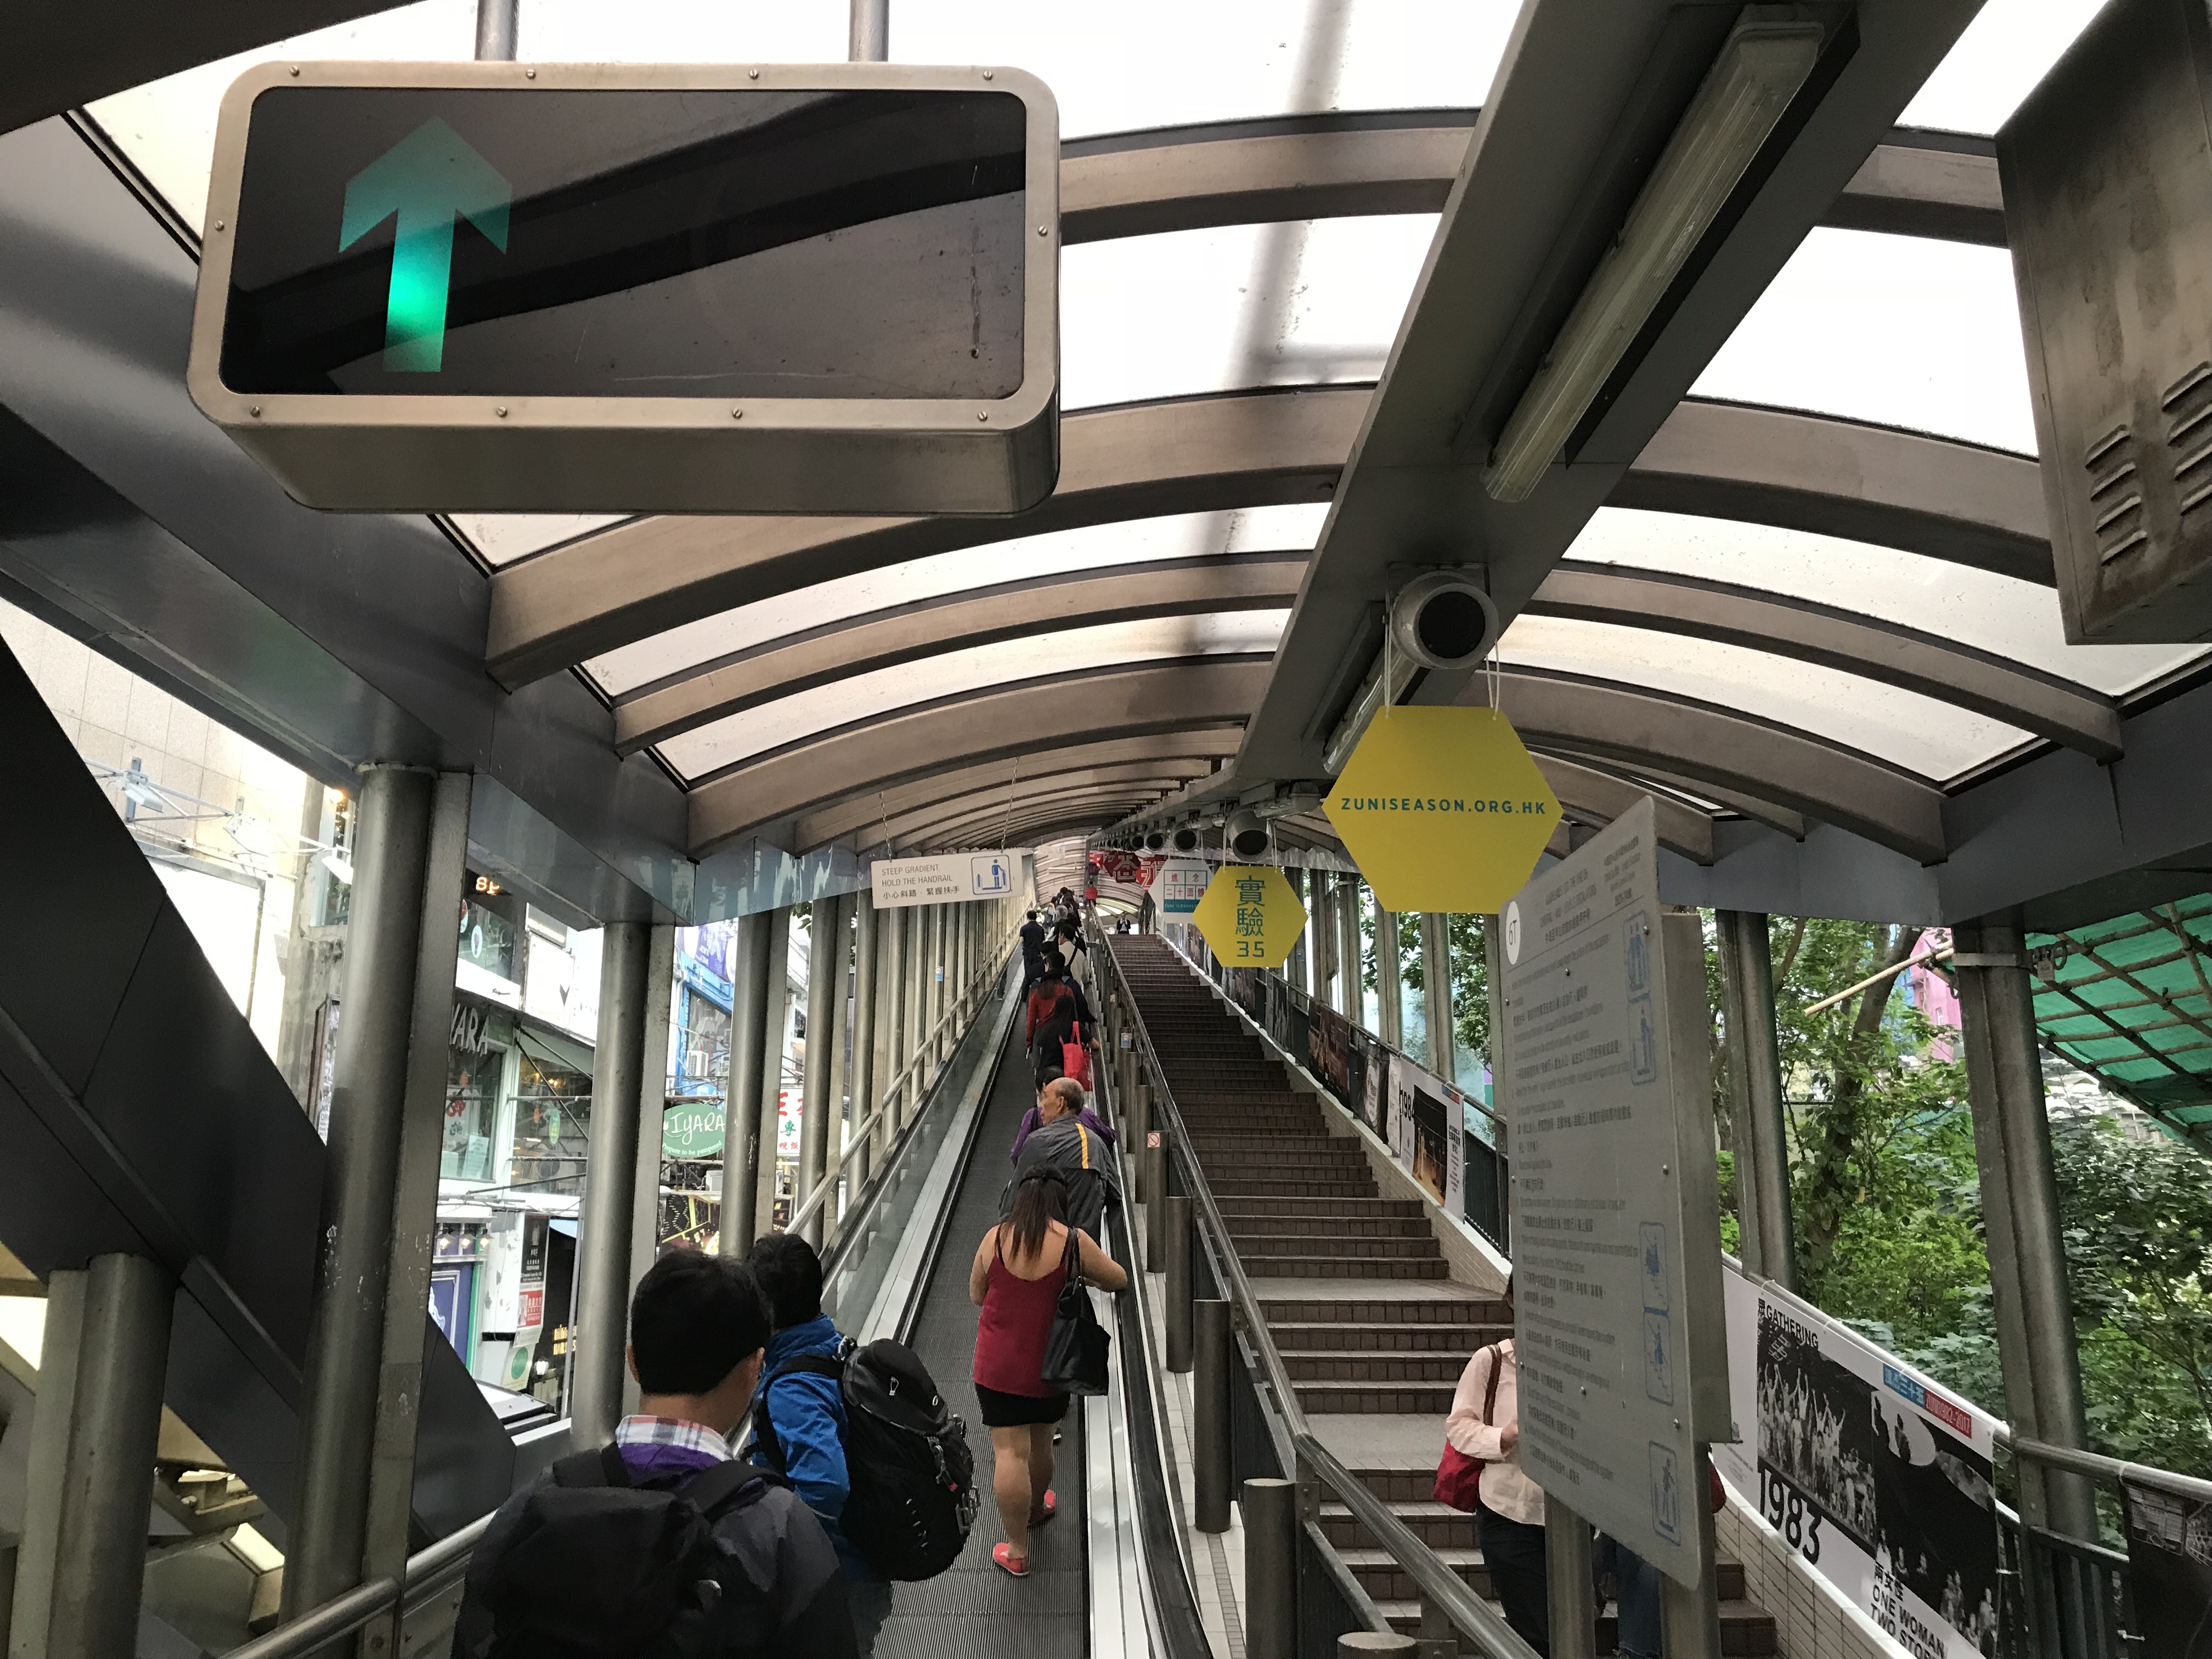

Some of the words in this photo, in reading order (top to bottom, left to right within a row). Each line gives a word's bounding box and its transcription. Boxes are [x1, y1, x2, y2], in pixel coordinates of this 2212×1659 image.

[1341, 797, 1546, 815] ZUNISEASON.ORG.HK
[881, 867, 903, 876] STEEP
[882, 878, 901, 887] HOLD
[903, 876, 916, 885] THE
[917, 874, 953, 884] HANDRAIL
[1234, 874, 1266, 937] 實驗
[1509, 919, 1517, 946] 6T
[1236, 941, 1265, 958] 35
[696, 1139, 723, 1156] pampered
[1766, 1304, 1819, 1350] GATHERING
[1757, 1463, 1820, 1565] 1983
[1871, 1602, 1897, 1637] TWO
[1872, 1584, 1897, 1617] ONE
[1899, 1604, 1945, 1659] WOMAN
